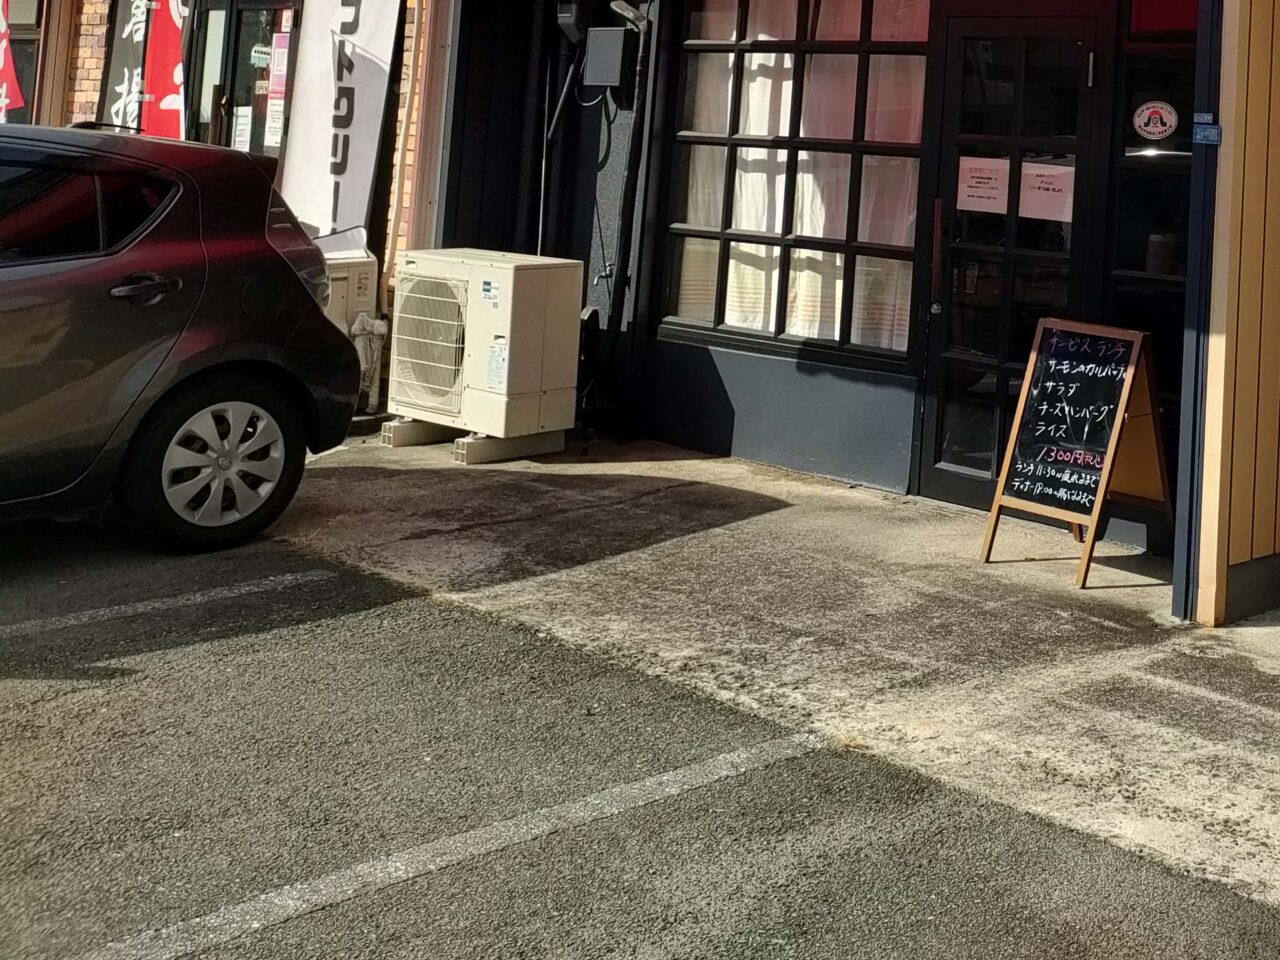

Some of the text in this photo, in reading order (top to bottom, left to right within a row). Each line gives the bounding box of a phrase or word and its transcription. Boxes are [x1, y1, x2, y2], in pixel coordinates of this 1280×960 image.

[1043, 380, 1081, 397] サラダ
[1037, 400, 1115, 423] チーズハンバーグ
[1034, 420, 1067, 438] ライス
